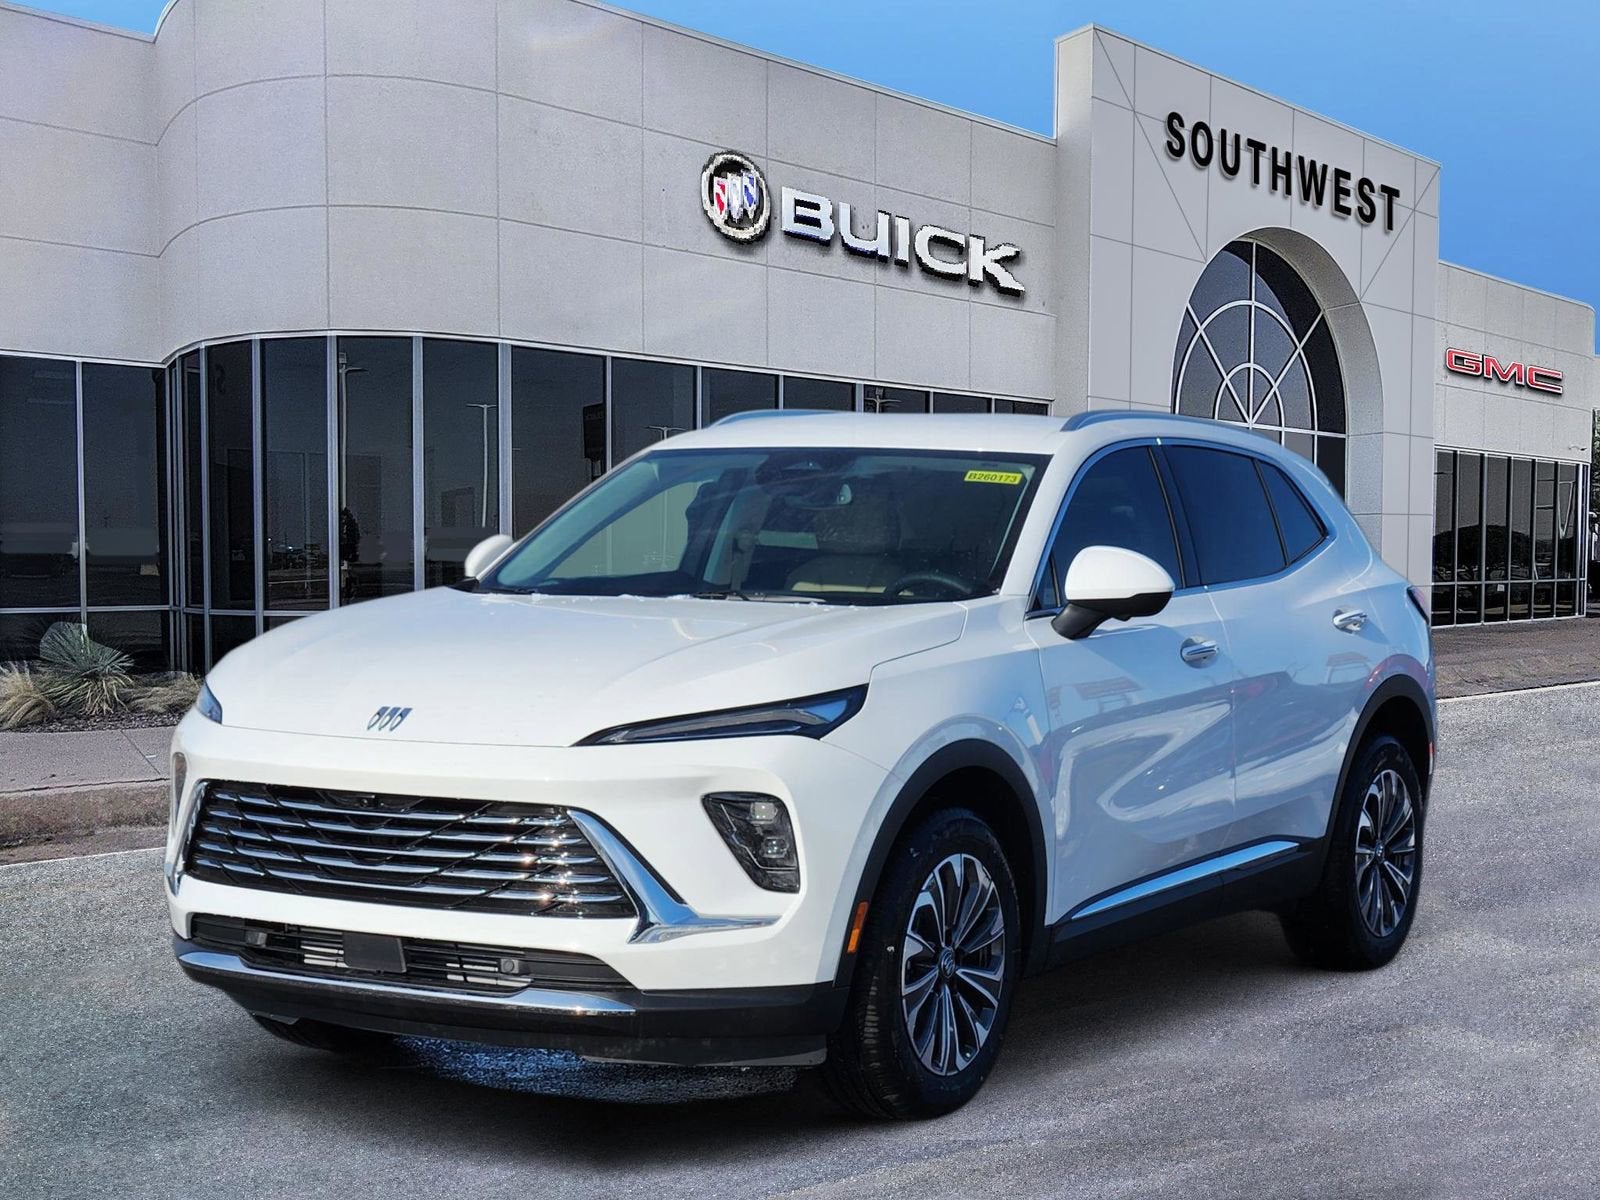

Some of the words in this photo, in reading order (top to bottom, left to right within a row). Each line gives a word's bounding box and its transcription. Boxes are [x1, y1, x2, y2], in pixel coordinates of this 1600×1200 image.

[1166, 112, 1400, 231] SOUTHWEST
[781, 186, 1025, 296] BUICK
[1446, 347, 1563, 395] GMC
[967, 472, 1018, 483] B260173
